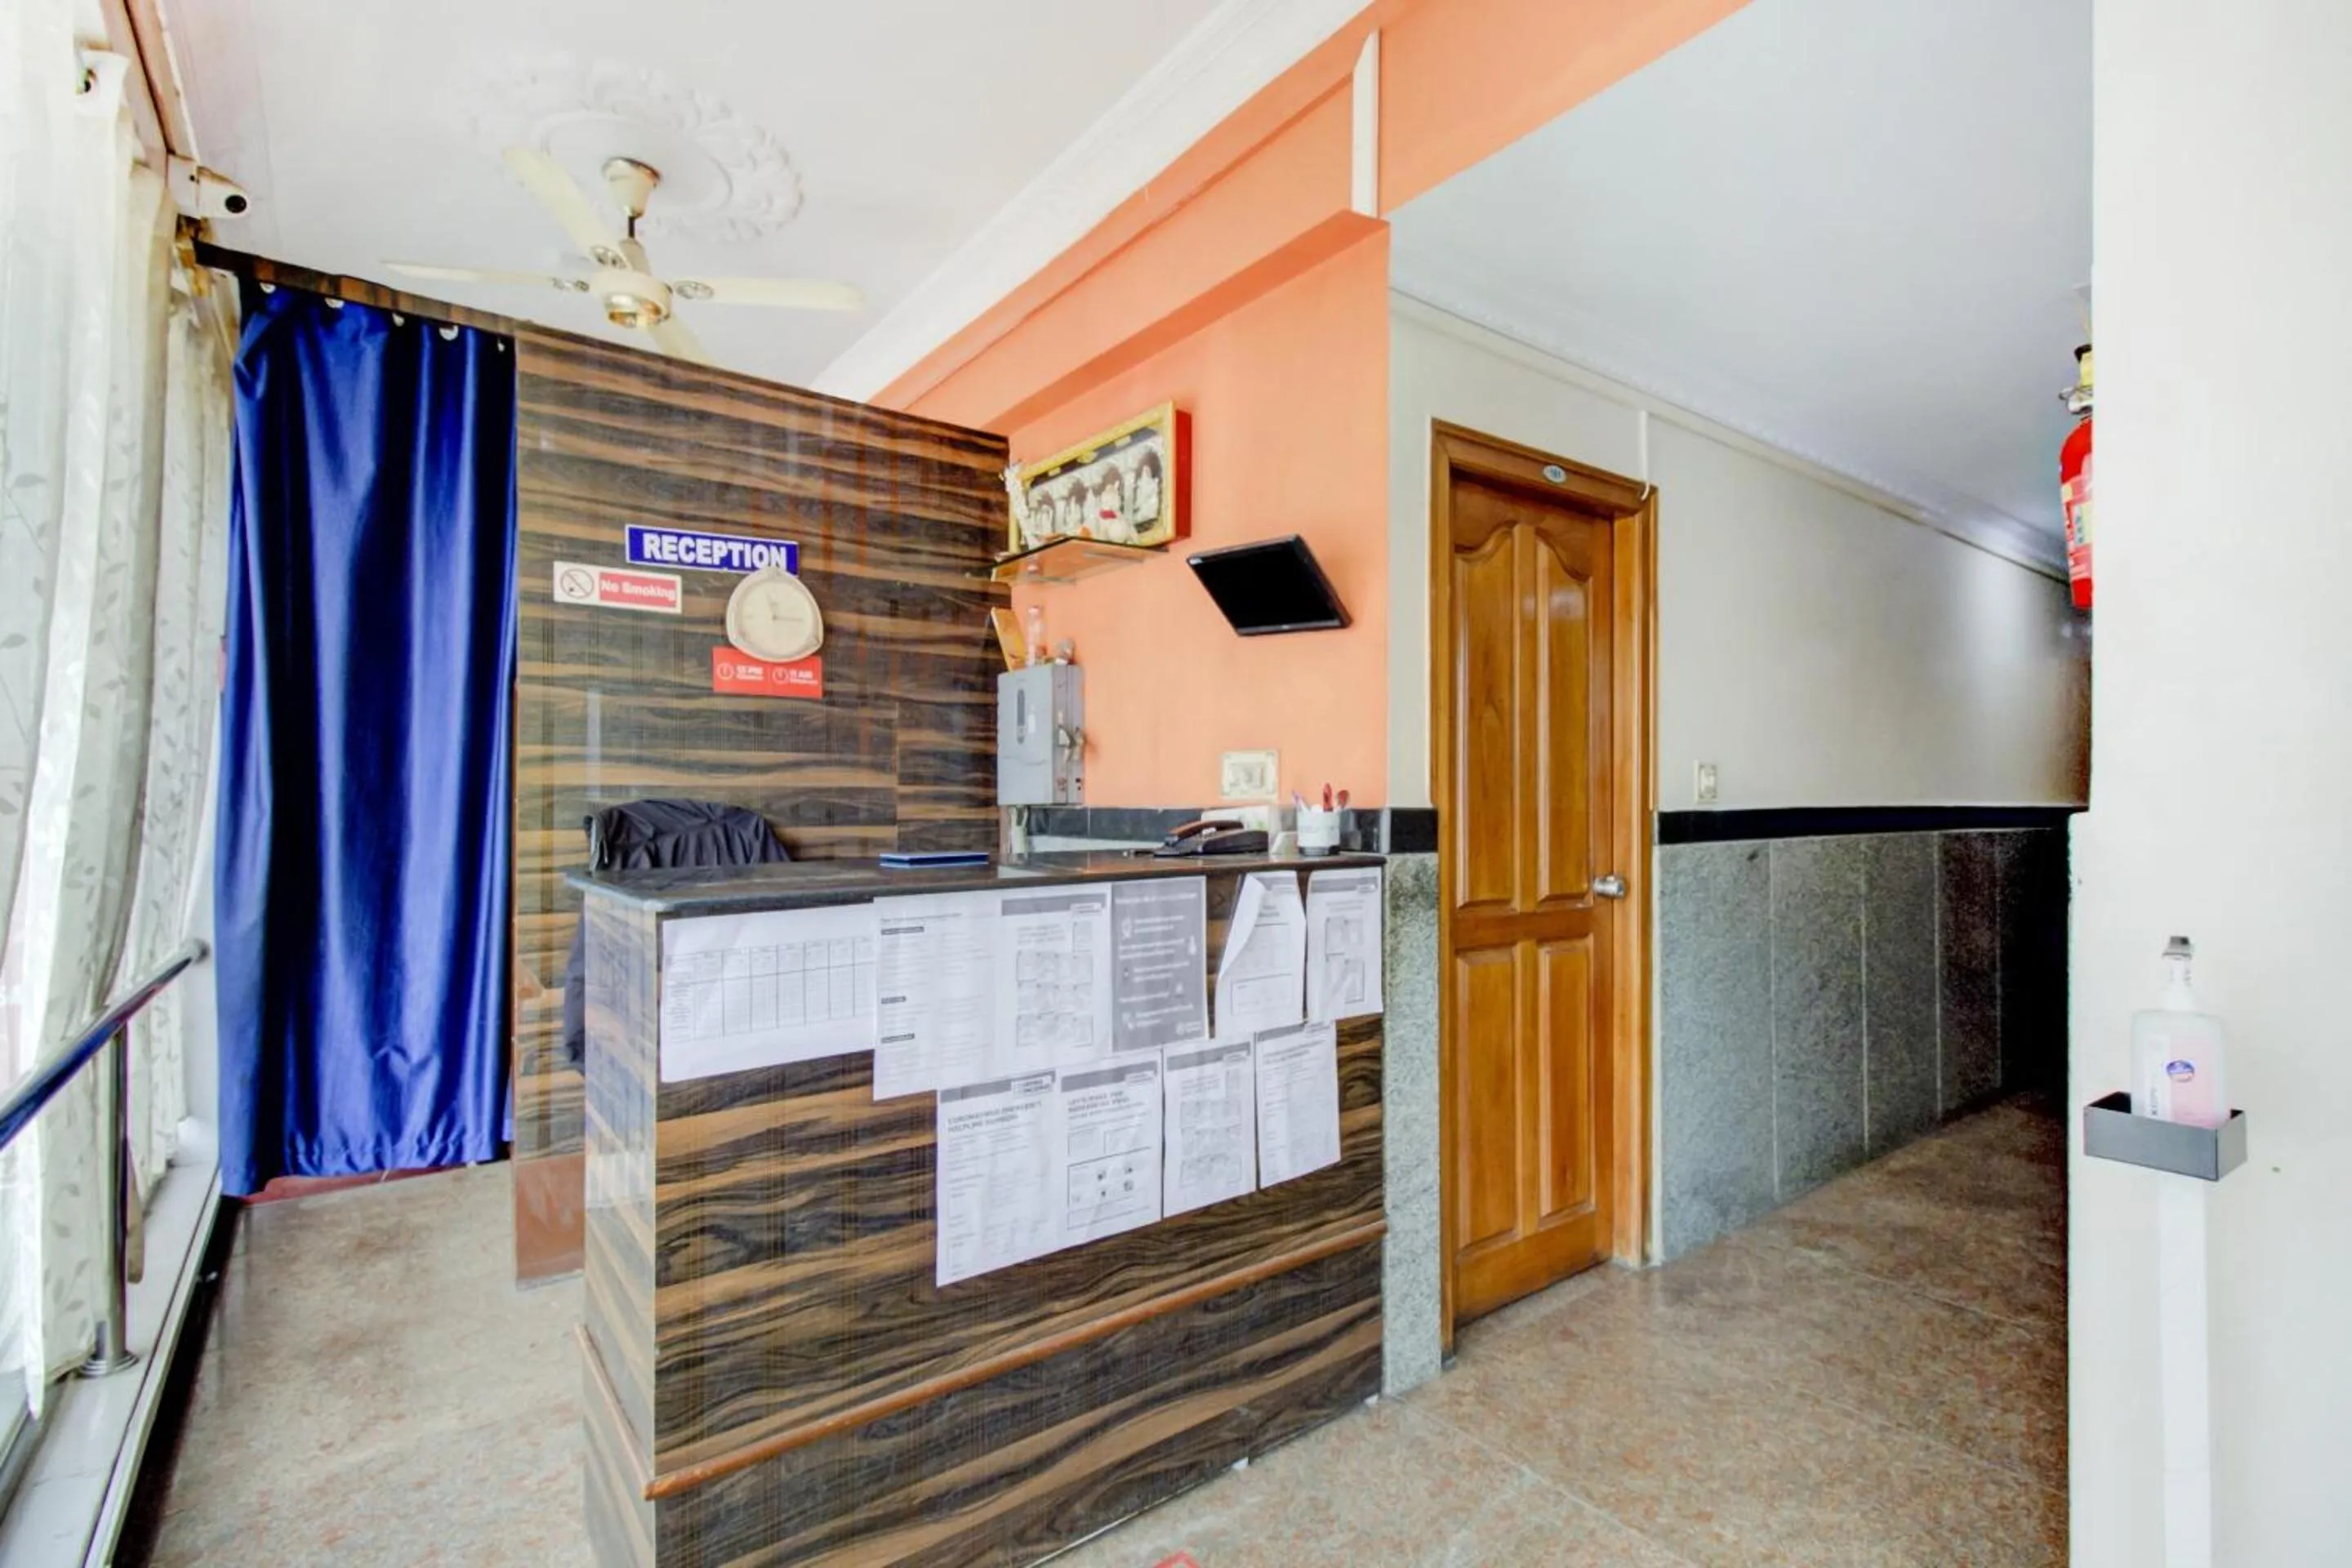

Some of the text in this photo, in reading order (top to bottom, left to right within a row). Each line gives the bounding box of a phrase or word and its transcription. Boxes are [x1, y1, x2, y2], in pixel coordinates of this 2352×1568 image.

[643, 532, 787, 570] RECEPTION
[601, 579, 676, 601] No Smoking
